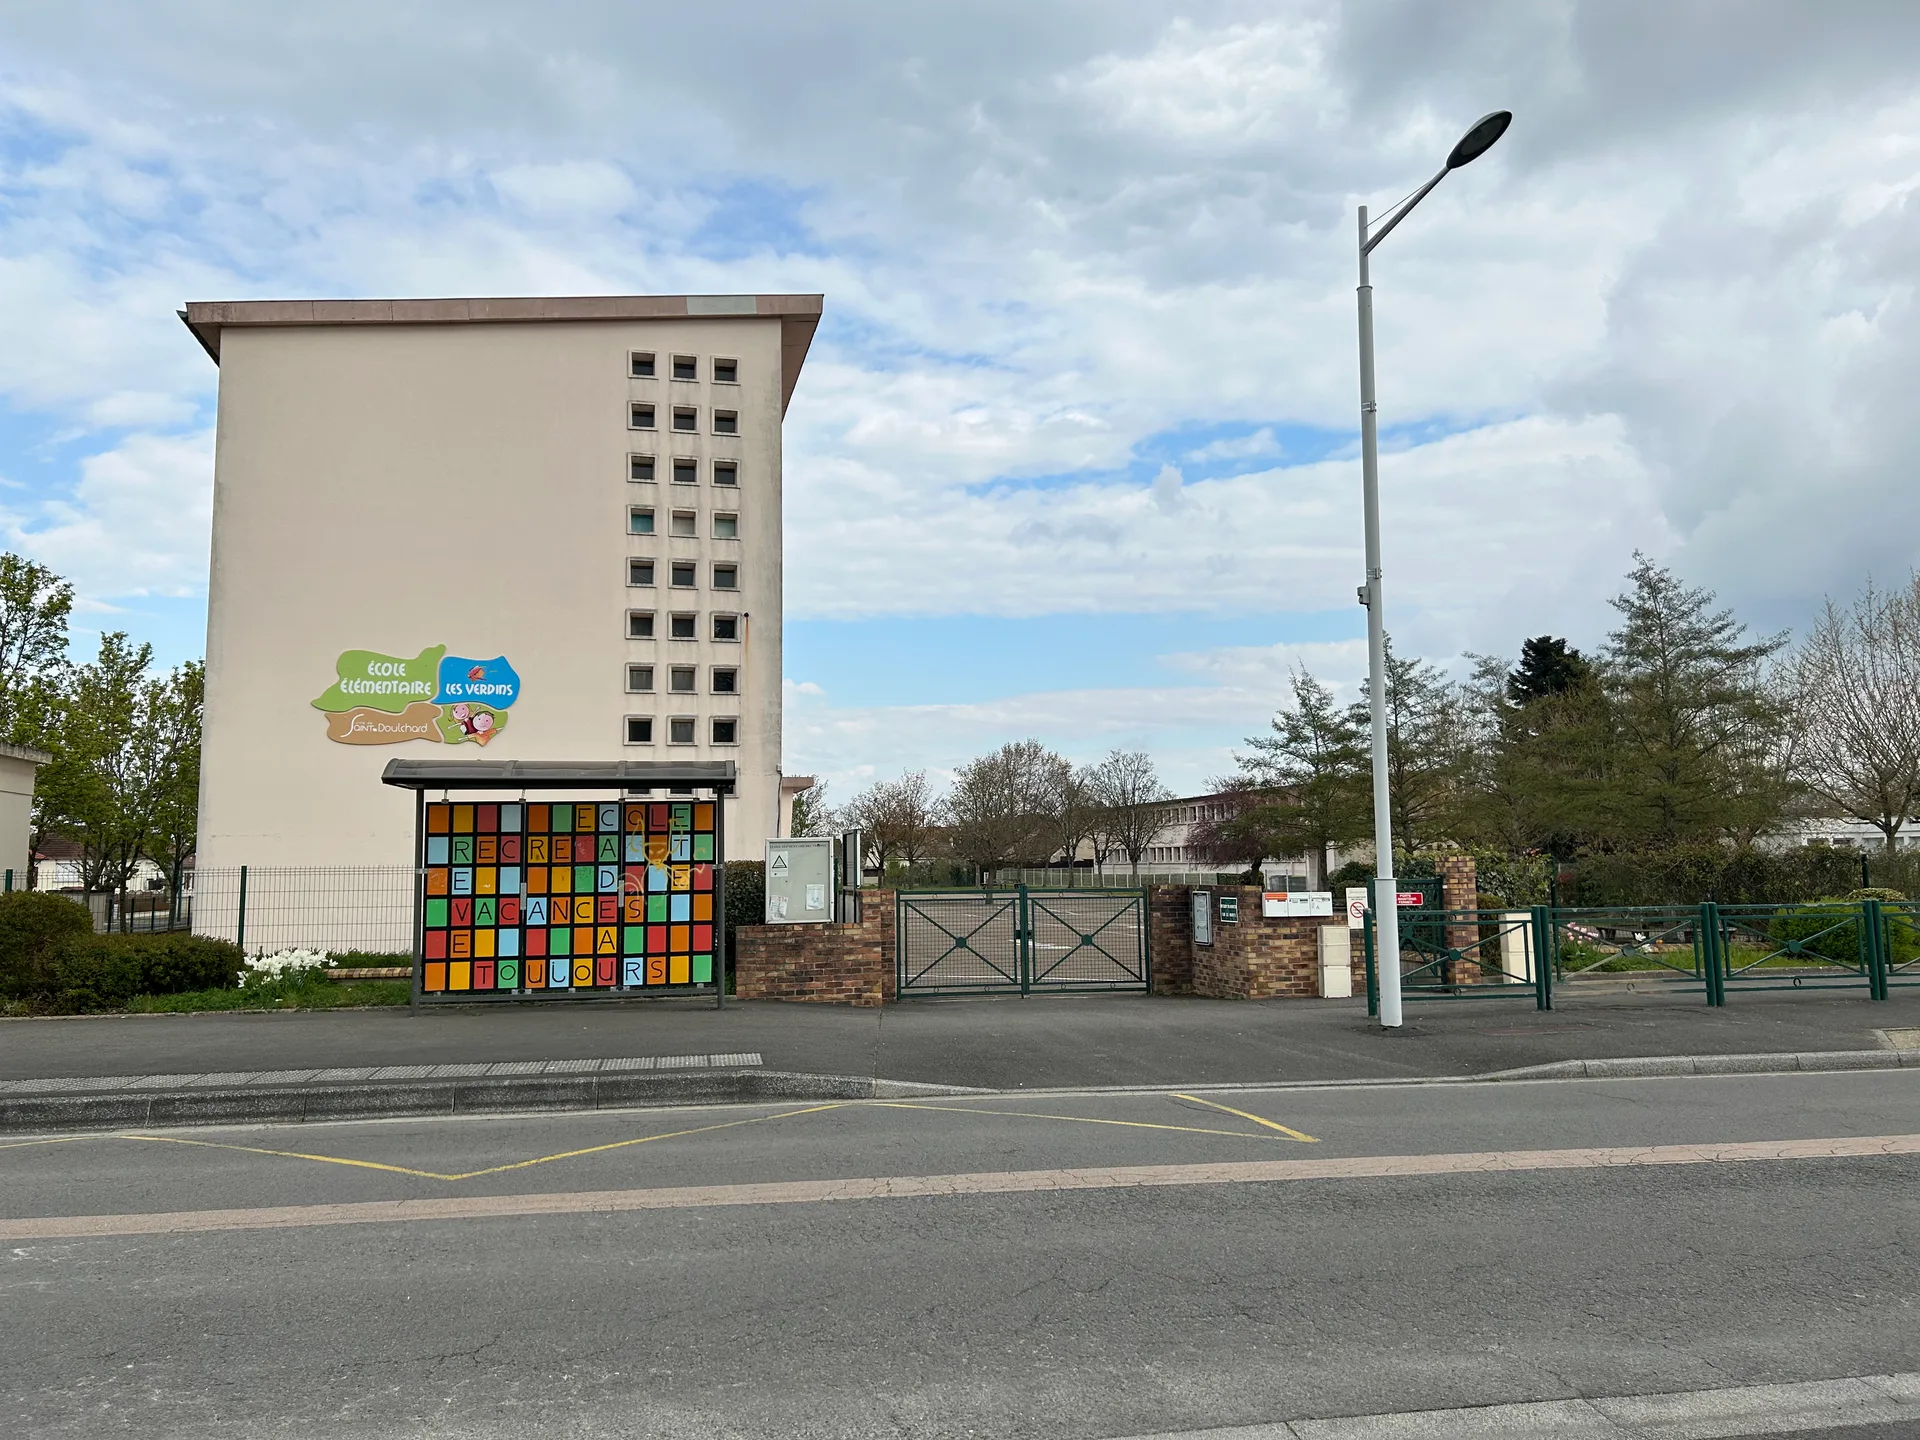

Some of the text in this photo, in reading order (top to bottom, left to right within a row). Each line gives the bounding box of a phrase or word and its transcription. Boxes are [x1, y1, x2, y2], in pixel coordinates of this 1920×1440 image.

[367, 660, 406, 677] ÉCOLE
[340, 677, 432, 696] ÉLÉMENTAIRE
[445, 683, 514, 696] LES VERDINS
[577, 807, 689, 829] ECOLE
[453, 838, 572, 862] RECRE
[454, 899, 642, 922] VACANCES
